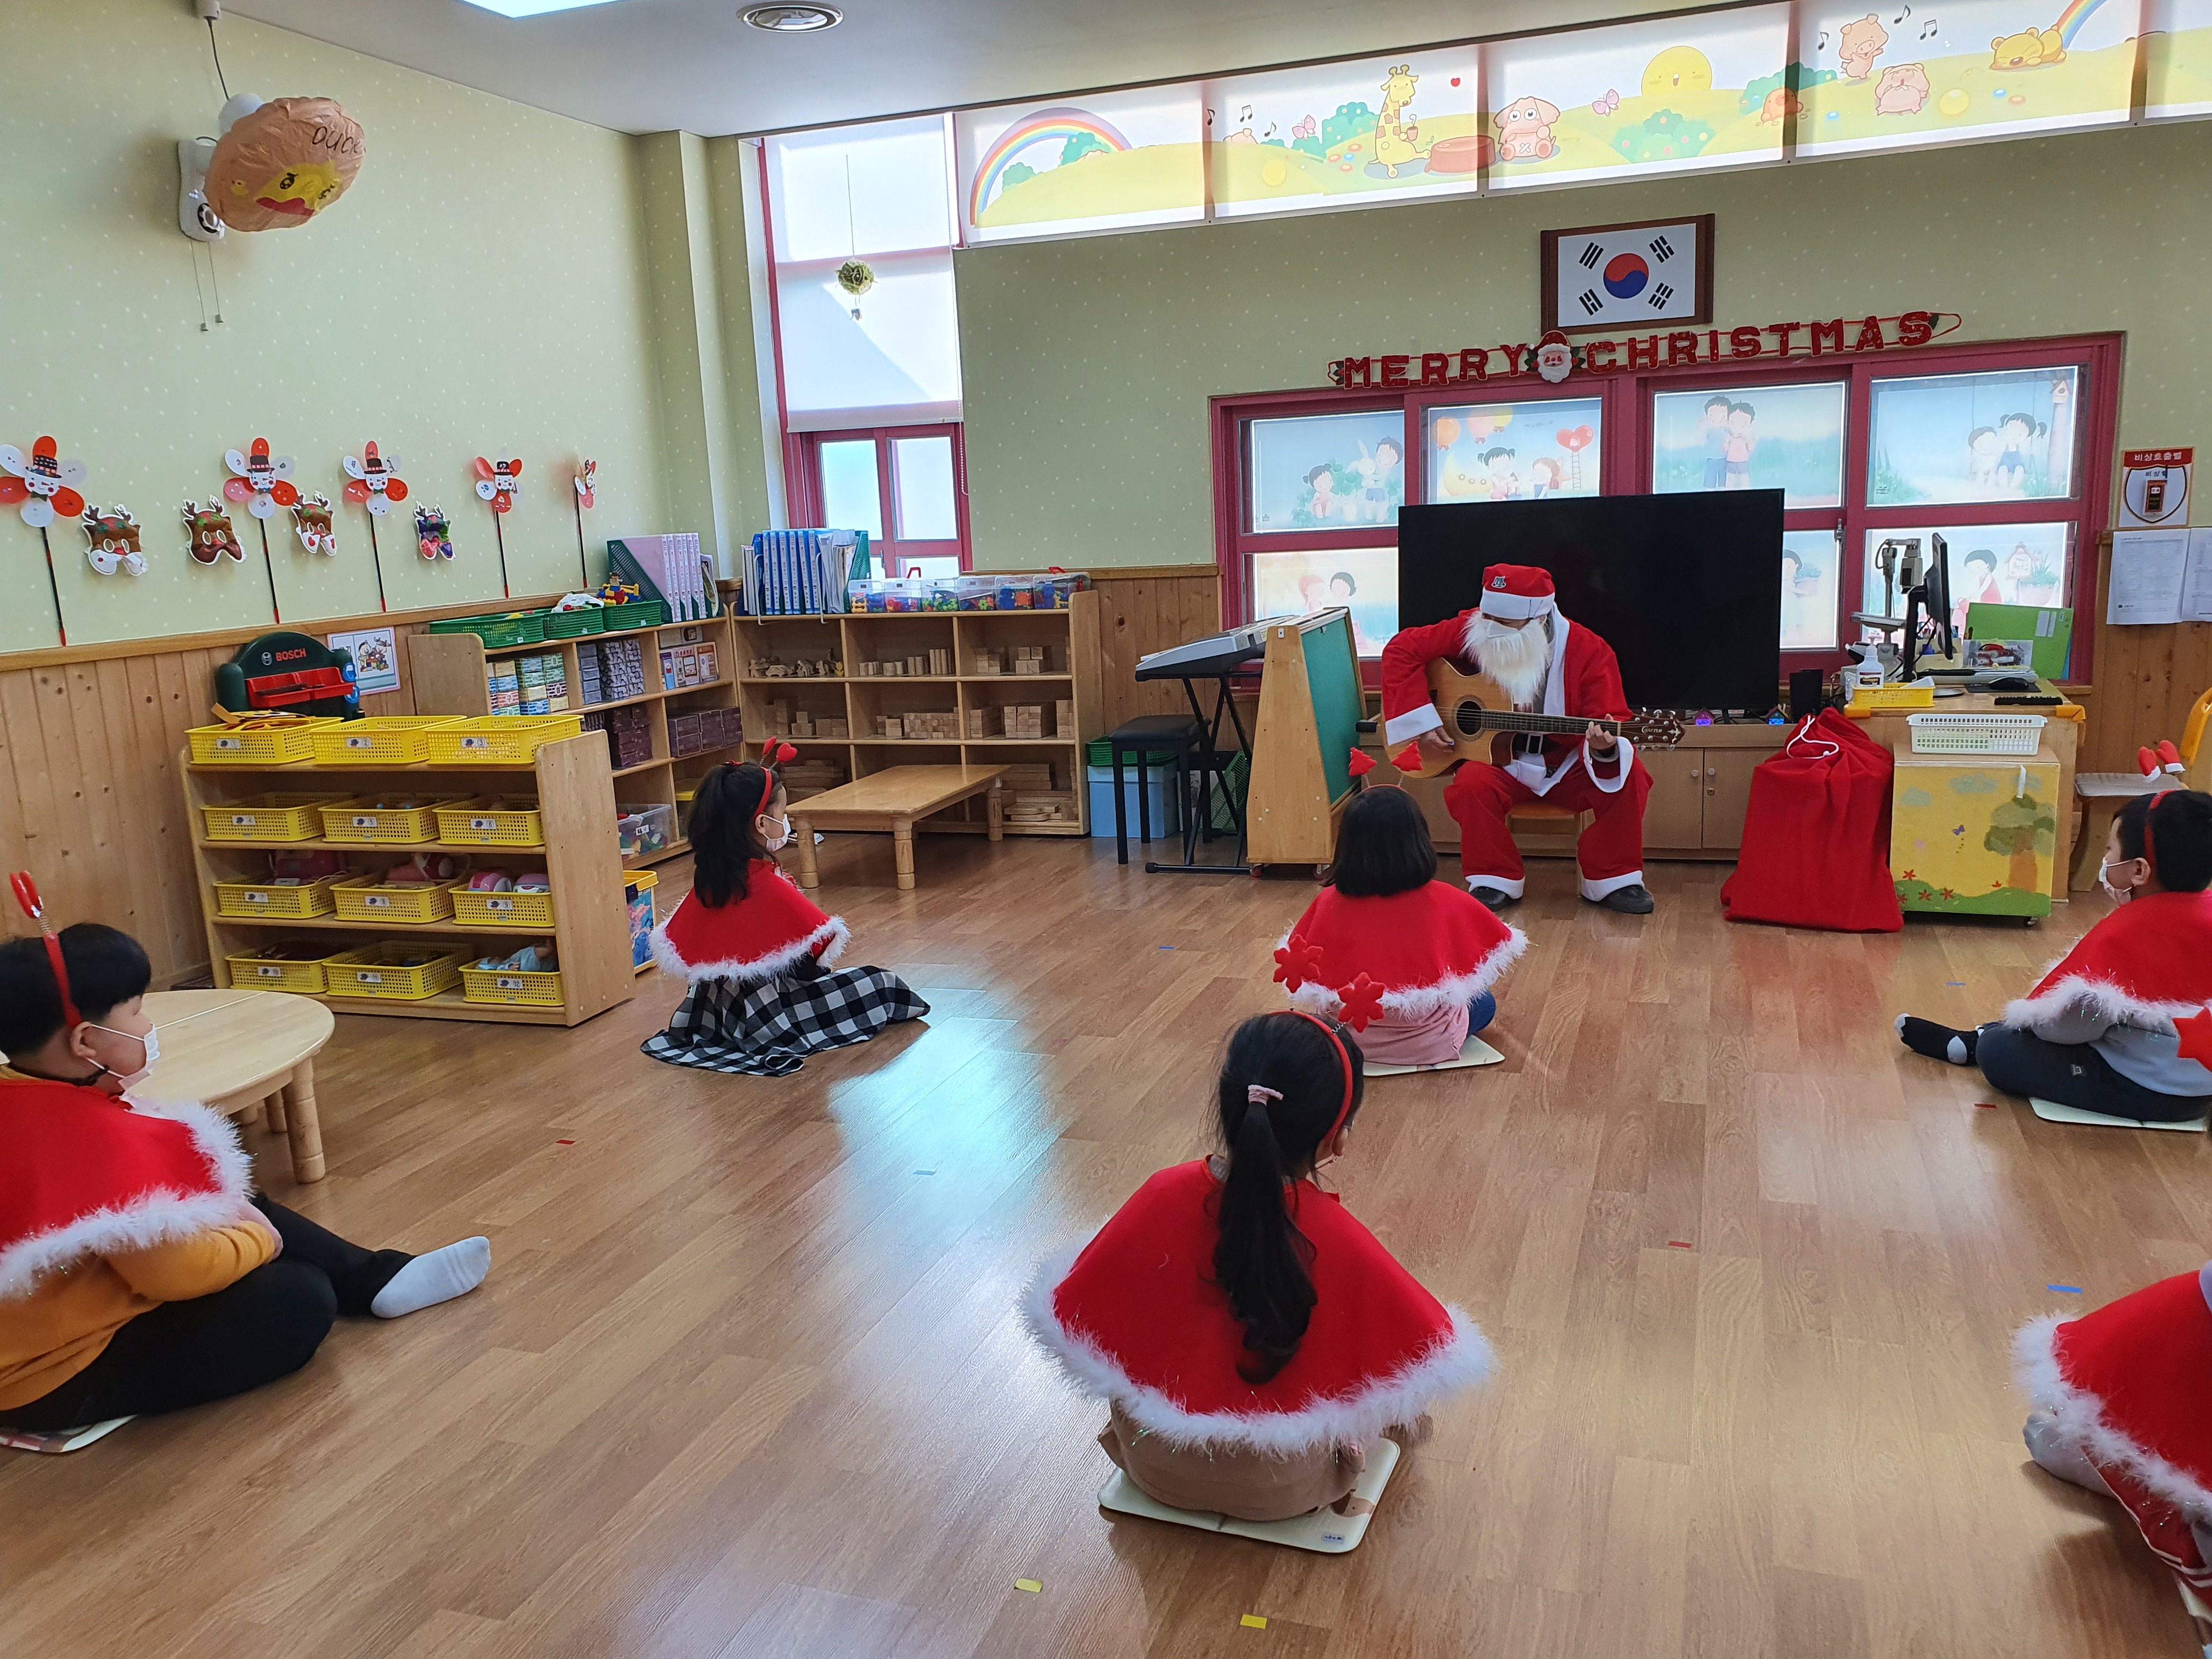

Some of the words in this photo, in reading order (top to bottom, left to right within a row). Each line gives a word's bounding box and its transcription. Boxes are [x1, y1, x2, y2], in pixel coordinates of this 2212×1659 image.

[1344, 343, 1527, 390] MERRY
[1587, 311, 1934, 374] CHRISTMAS
[276, 648, 306, 662] BOSCH
